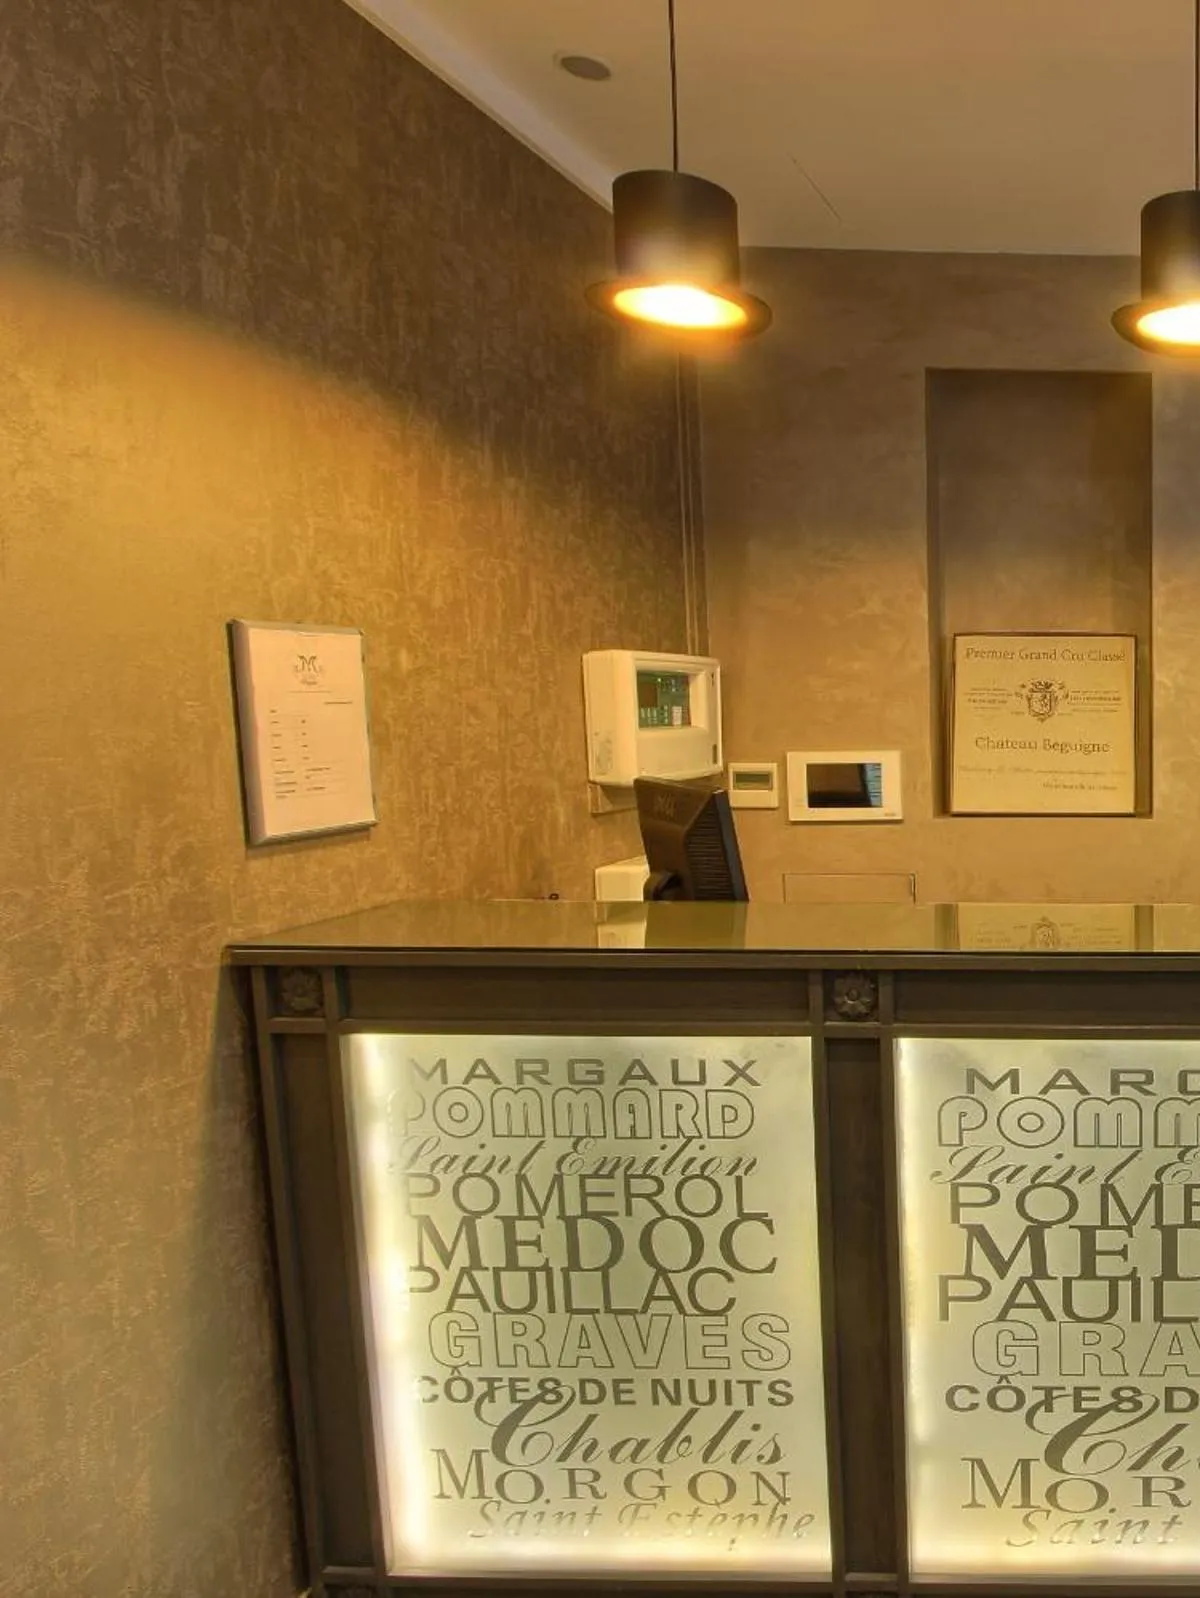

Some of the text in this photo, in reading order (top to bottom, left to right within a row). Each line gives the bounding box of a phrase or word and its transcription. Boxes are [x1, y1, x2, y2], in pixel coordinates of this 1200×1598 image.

[966, 647, 1015, 660] Premier
[1018, 648, 1058, 661] Grand
[1061, 649, 1085, 662] Cru
[406, 1058, 761, 1086] MARGAUX
[388, 1086, 755, 1139] POMMARD
[390, 1136, 760, 1177] Saint Emilion
[930, 1144, 1143, 1185] Saint
[404, 1173, 769, 1218] POMEROL
[409, 1215, 778, 1274] MEDOC
[408, 1266, 737, 1315] PAUILLAC
[429, 1311, 791, 1371] GRAVES
[580, 1377, 634, 1405] DE
[651, 1378, 794, 1407] NUITS
[473, 1384, 786, 1467] Chablis
[431, 1448, 791, 1507] MORGON
[468, 1499, 603, 1538] Saint
[1005, 1506, 1184, 1547] Saint
